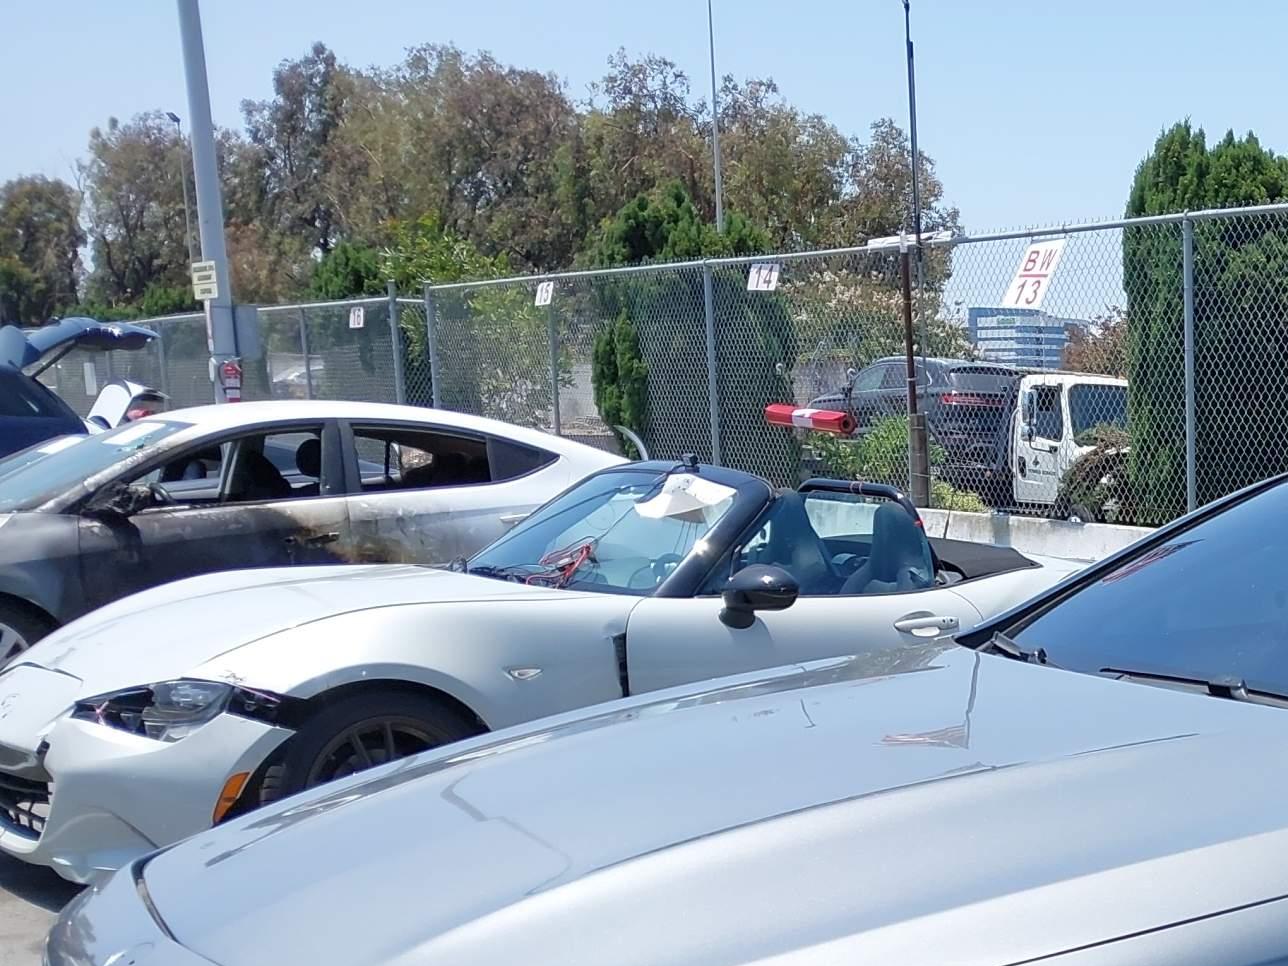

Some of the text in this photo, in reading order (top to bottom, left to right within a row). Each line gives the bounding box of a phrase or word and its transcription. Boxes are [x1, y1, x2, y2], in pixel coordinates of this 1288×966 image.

[1023, 249, 1058, 273] BW
[755, 265, 774, 289] 14
[539, 283, 551, 305] 15
[1014, 280, 1041, 305] 13
